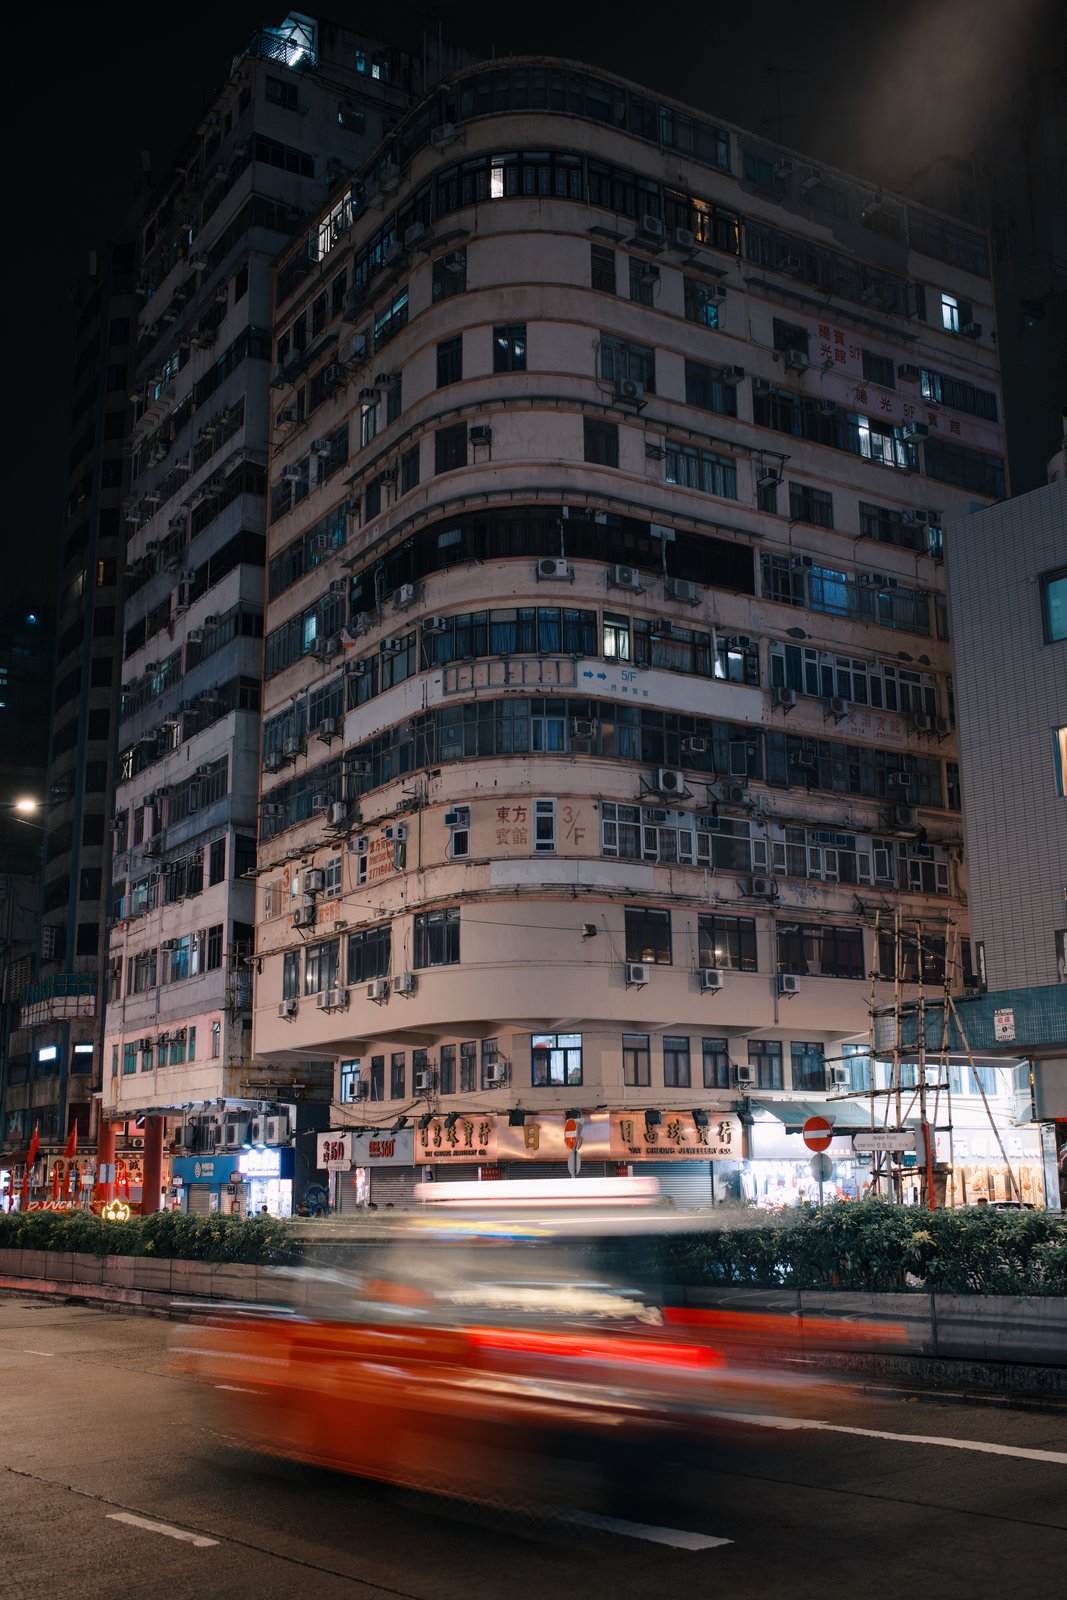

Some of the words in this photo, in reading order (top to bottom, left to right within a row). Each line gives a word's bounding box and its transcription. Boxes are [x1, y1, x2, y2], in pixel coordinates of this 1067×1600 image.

[621, 669, 637, 681] 5/F
[496, 806, 527, 823] 東方
[562, 806, 586, 846] 3/F
